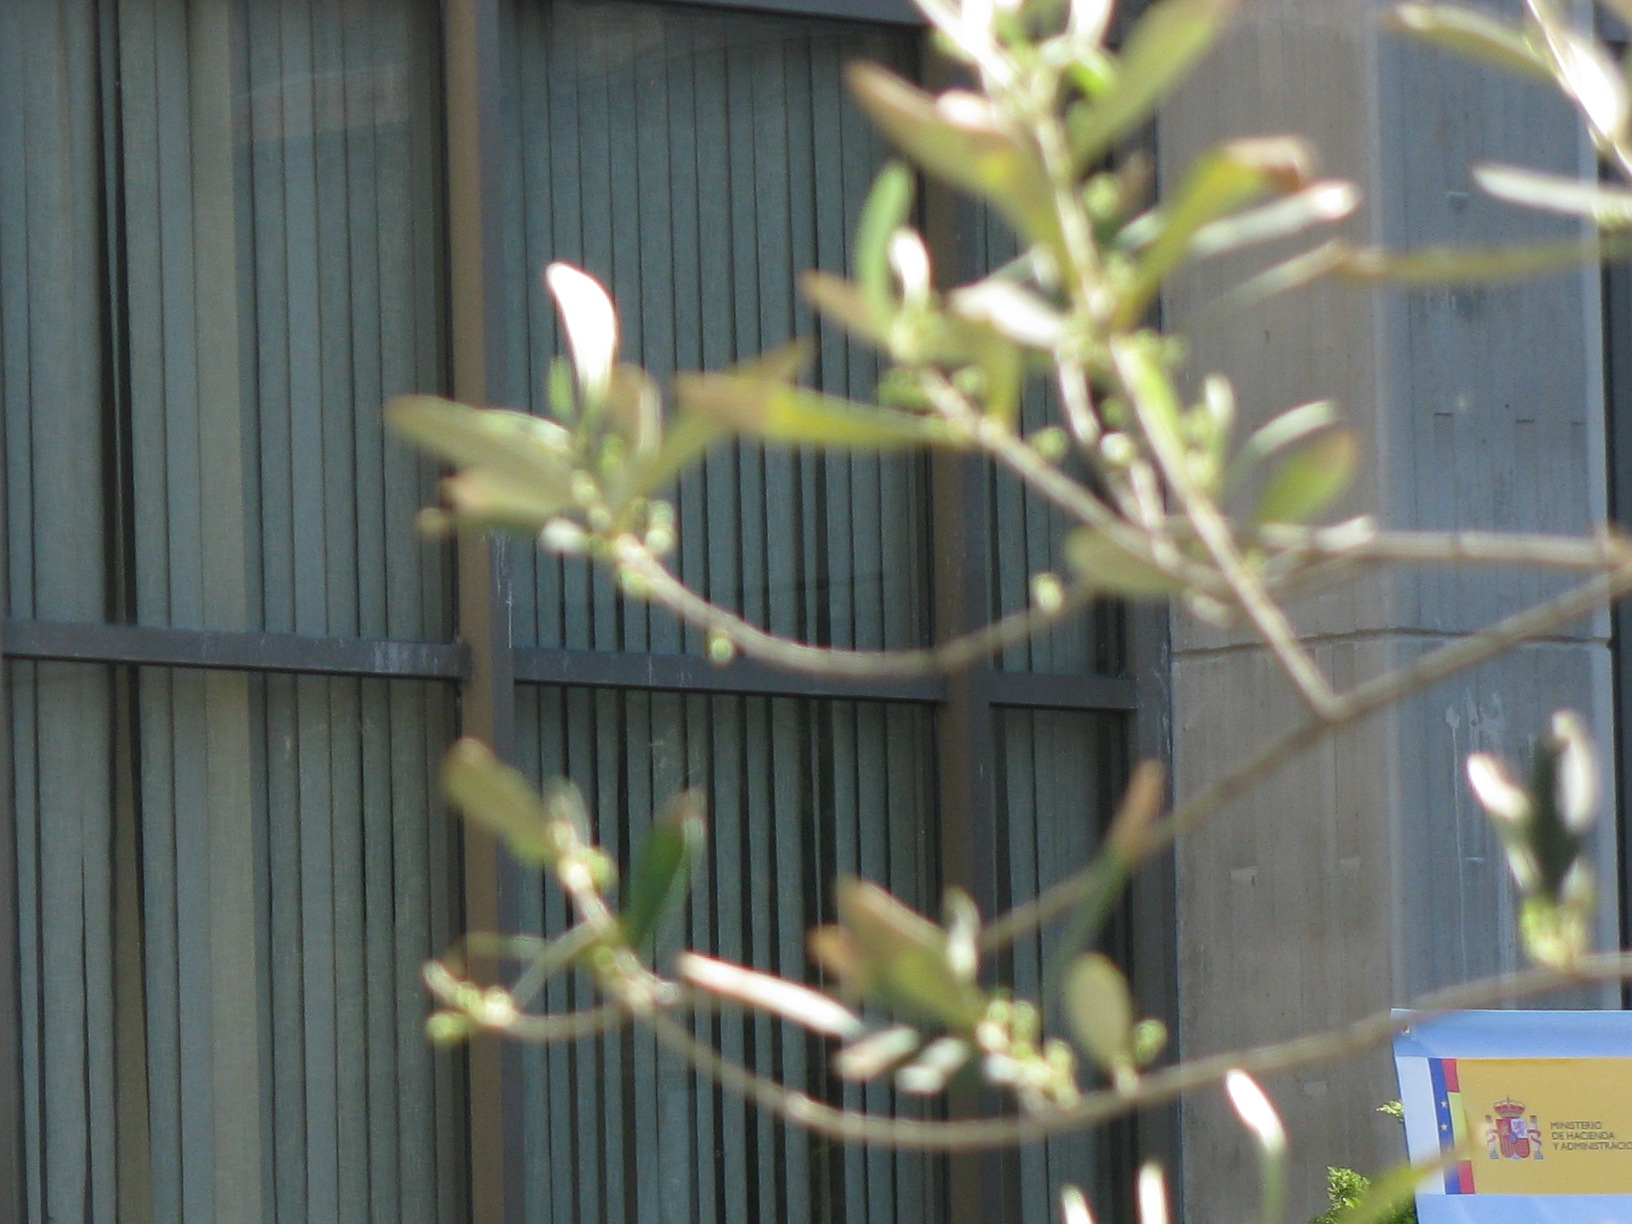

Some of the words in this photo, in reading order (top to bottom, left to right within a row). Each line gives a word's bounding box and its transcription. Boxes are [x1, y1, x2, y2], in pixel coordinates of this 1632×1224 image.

[1550, 1120, 1603, 1130] MINISTERIO
[1551, 1131, 1565, 1140] DE
[1566, 1131, 1615, 1140] HACIENDA
